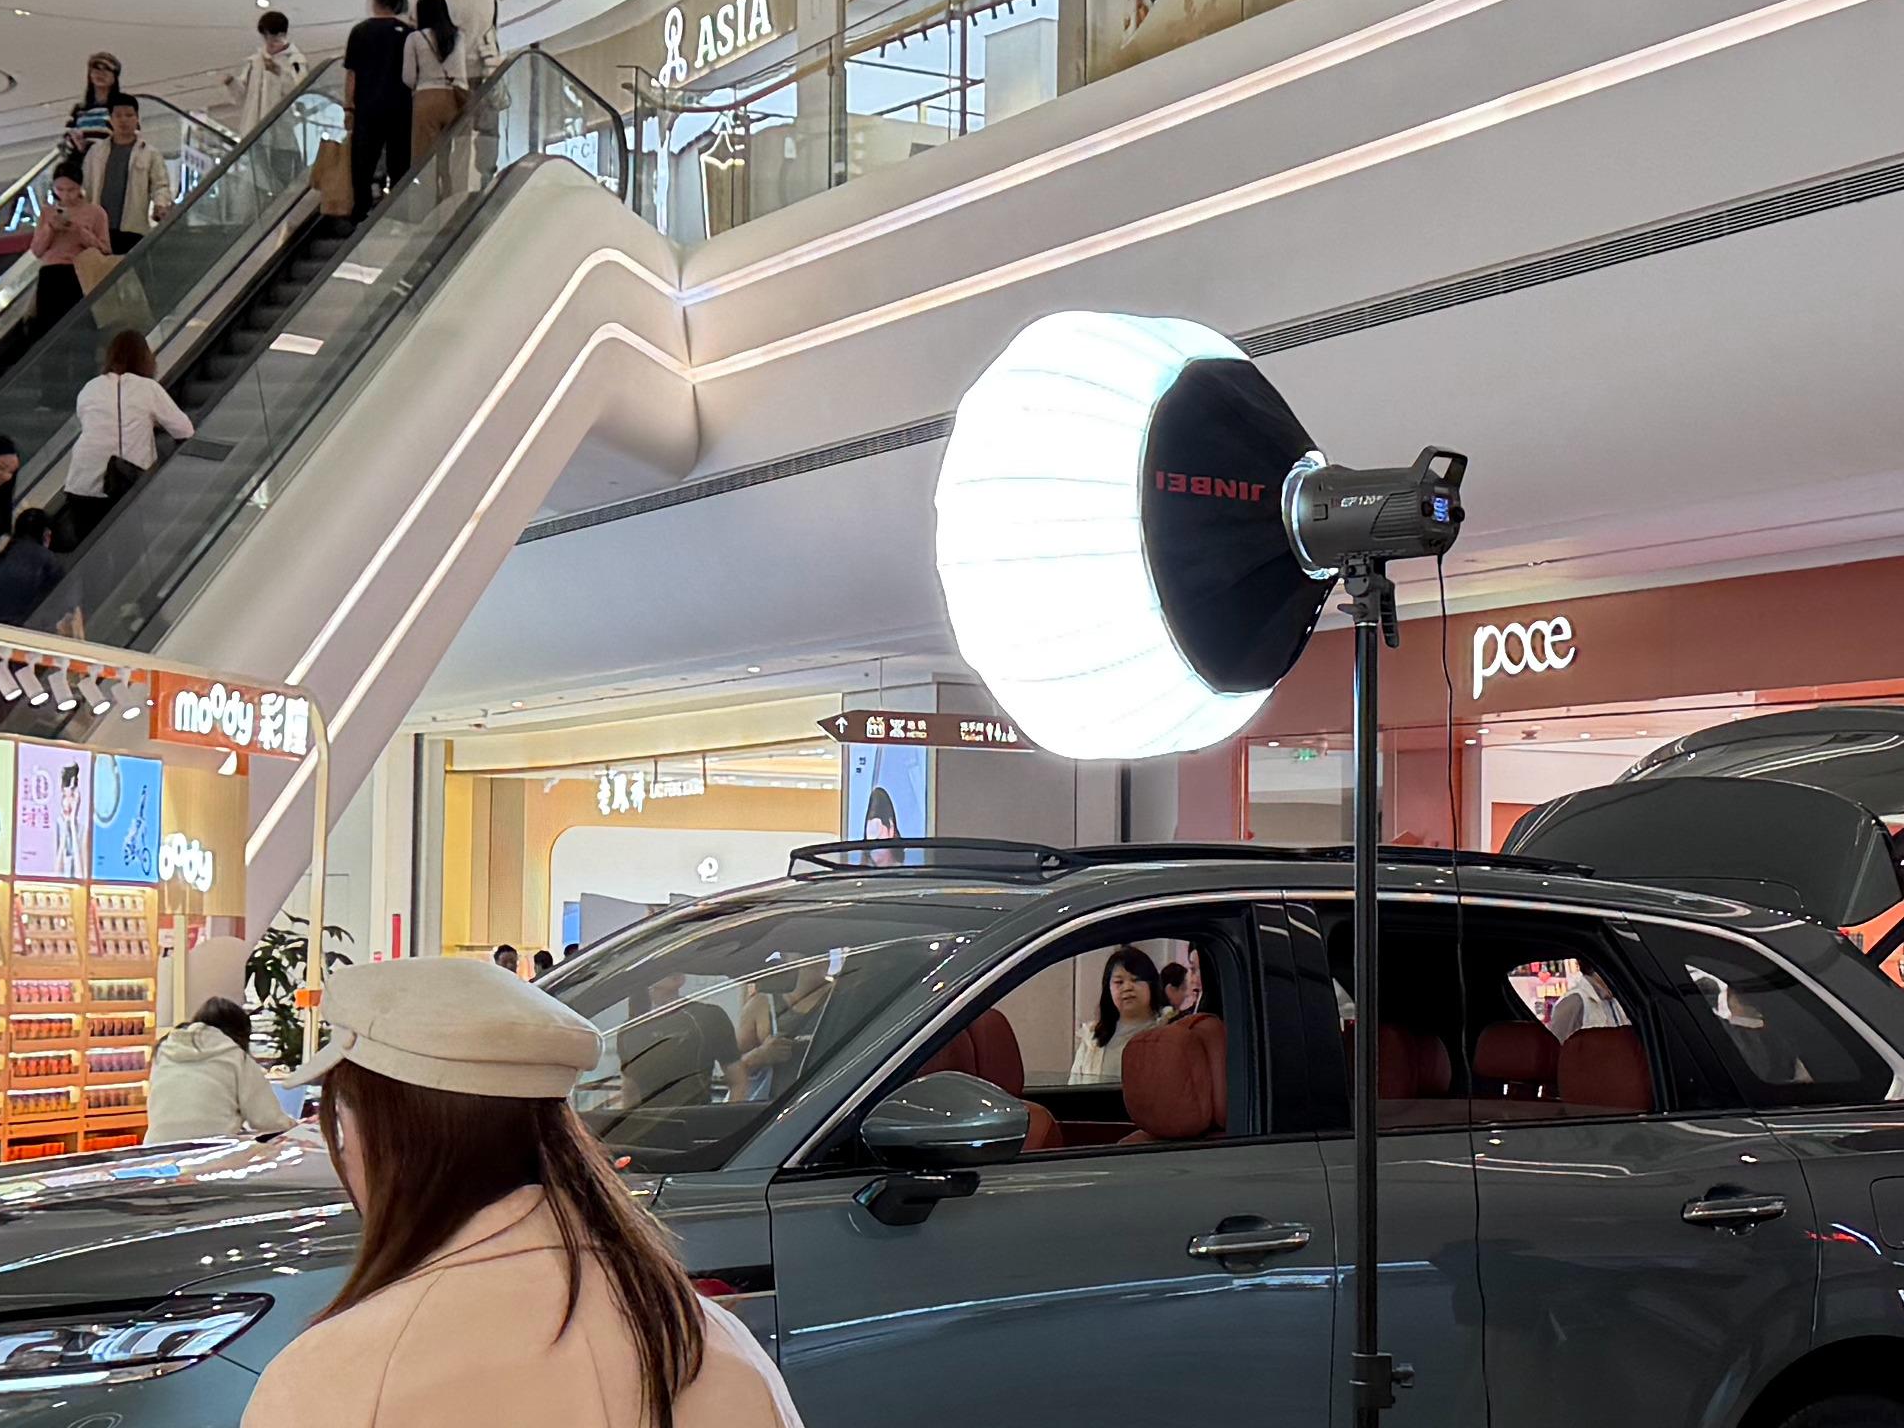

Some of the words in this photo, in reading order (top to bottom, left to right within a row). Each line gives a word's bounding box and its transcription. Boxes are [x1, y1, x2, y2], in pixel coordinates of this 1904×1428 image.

[1155, 471, 1266, 503] JINBEI
[175, 683, 255, 746] moody
[158, 833, 213, 893] oody
